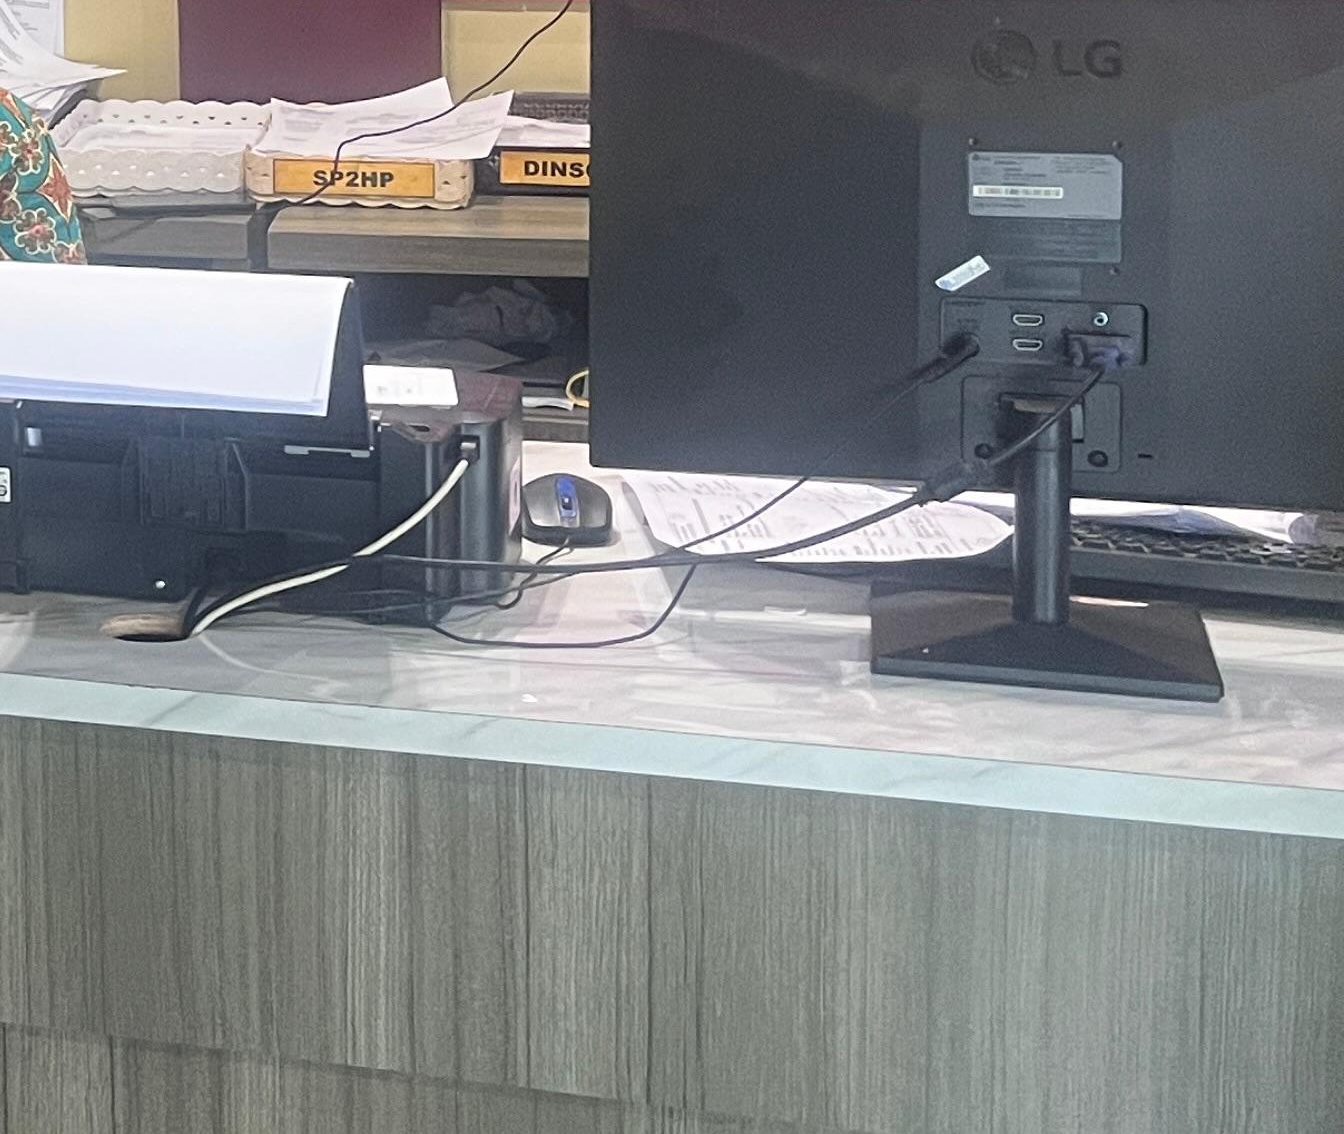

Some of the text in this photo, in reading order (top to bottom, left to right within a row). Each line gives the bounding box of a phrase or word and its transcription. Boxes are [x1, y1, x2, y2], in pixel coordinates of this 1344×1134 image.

[1053, 39, 1123, 79] LG
[524, 160, 590, 178] DINS
[313, 170, 394, 188] SP2HP
